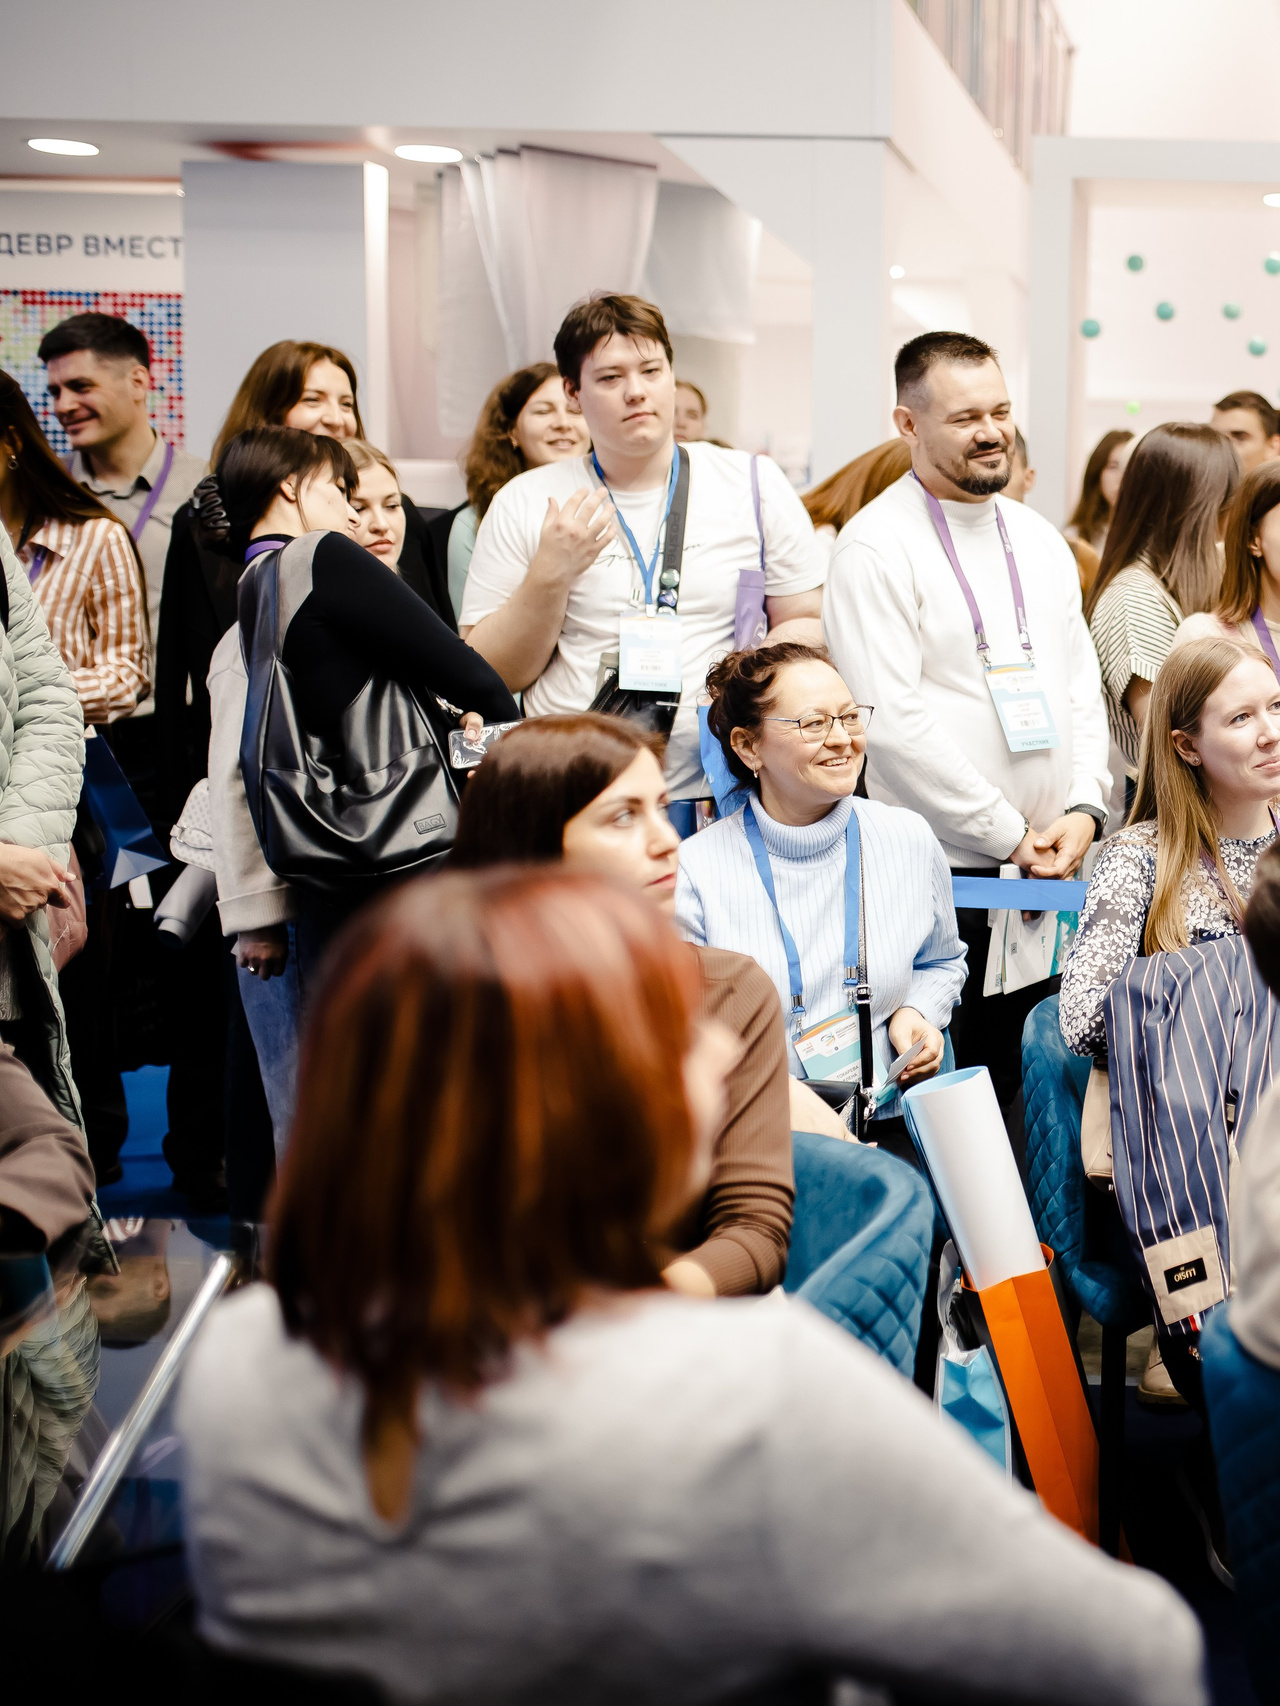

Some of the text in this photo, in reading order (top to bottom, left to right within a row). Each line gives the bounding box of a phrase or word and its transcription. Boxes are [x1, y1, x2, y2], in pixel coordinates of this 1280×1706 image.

[0, 232, 74, 257] ДЕВР
[1021, 739, 1050, 747] УЧАСТНИК
[1174, 1267, 1196, 1282] LUSIO
